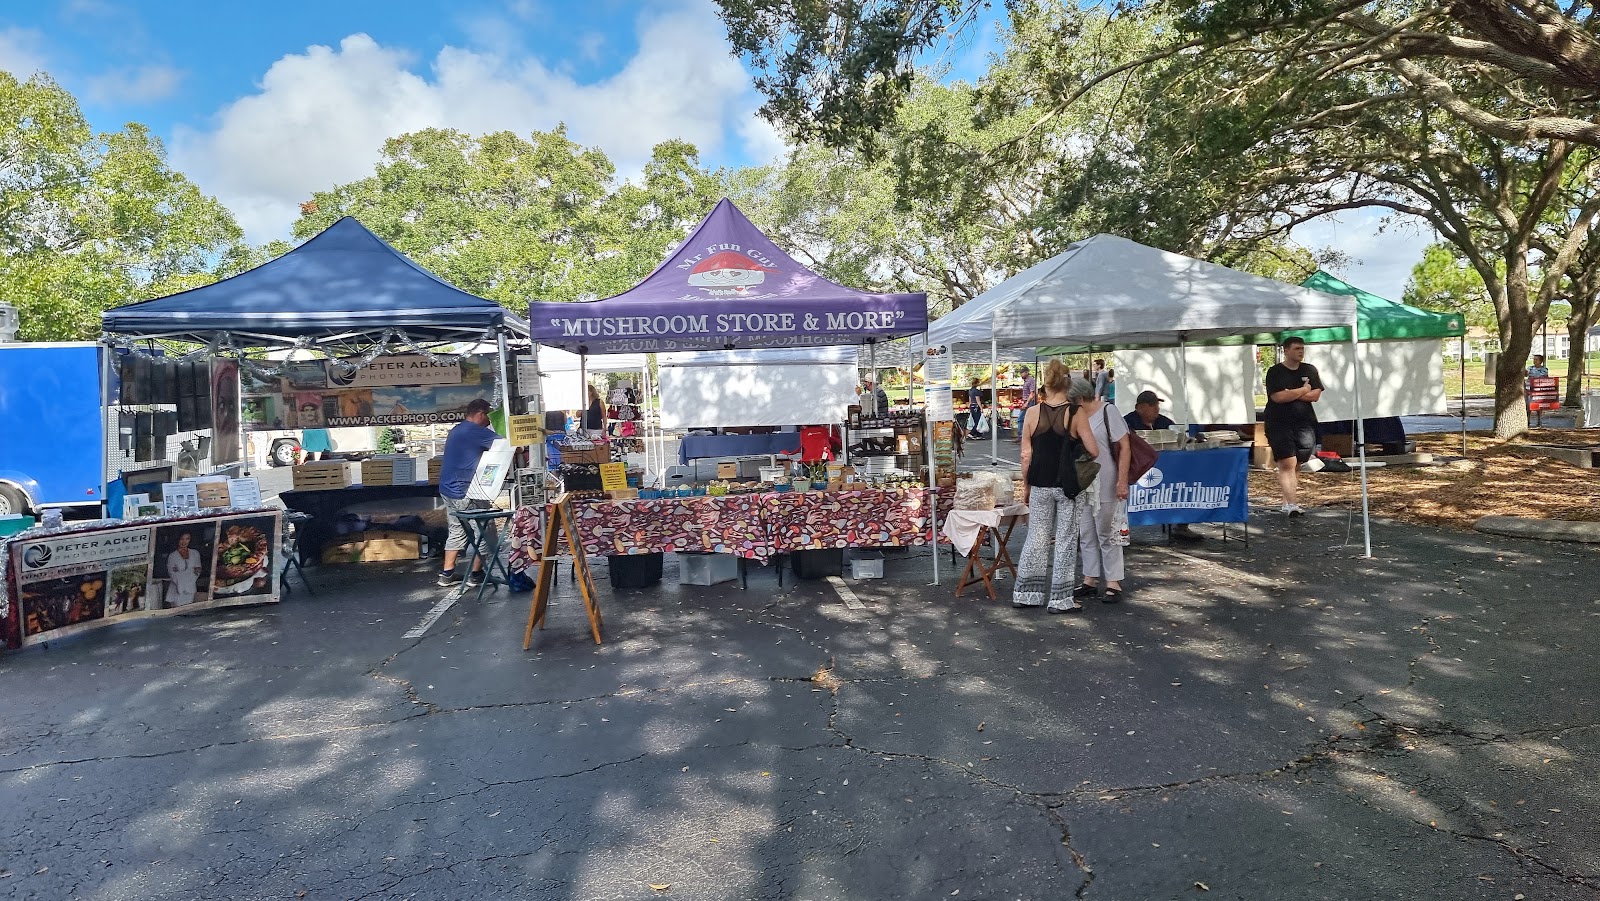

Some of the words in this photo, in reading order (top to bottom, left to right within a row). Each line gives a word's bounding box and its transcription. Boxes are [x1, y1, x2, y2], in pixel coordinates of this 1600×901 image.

[676, 254, 702, 271] Mr
[706, 243, 741, 256] Fun
[747, 249, 779, 268] Guy
[716, 313, 796, 333] STORE
[803, 312, 820, 331] &
[360, 361, 405, 372] PETER
[410, 360, 458, 370] ACKER
[360, 371, 460, 380] PHOTOGRAPHY
[327, 412, 466, 427] WWW.PACKERPHOTO.COM
[1129, 481, 1231, 506] Herald-Tribune
[1134, 503, 1222, 511] HERALDTRIBUNE.COM
[55, 541, 99, 553] PETER
[103, 534, 148, 547] ACKER
[54, 543, 148, 561] PHOTOGRAPHY
[57, 564, 99, 574] PORTRAITS
